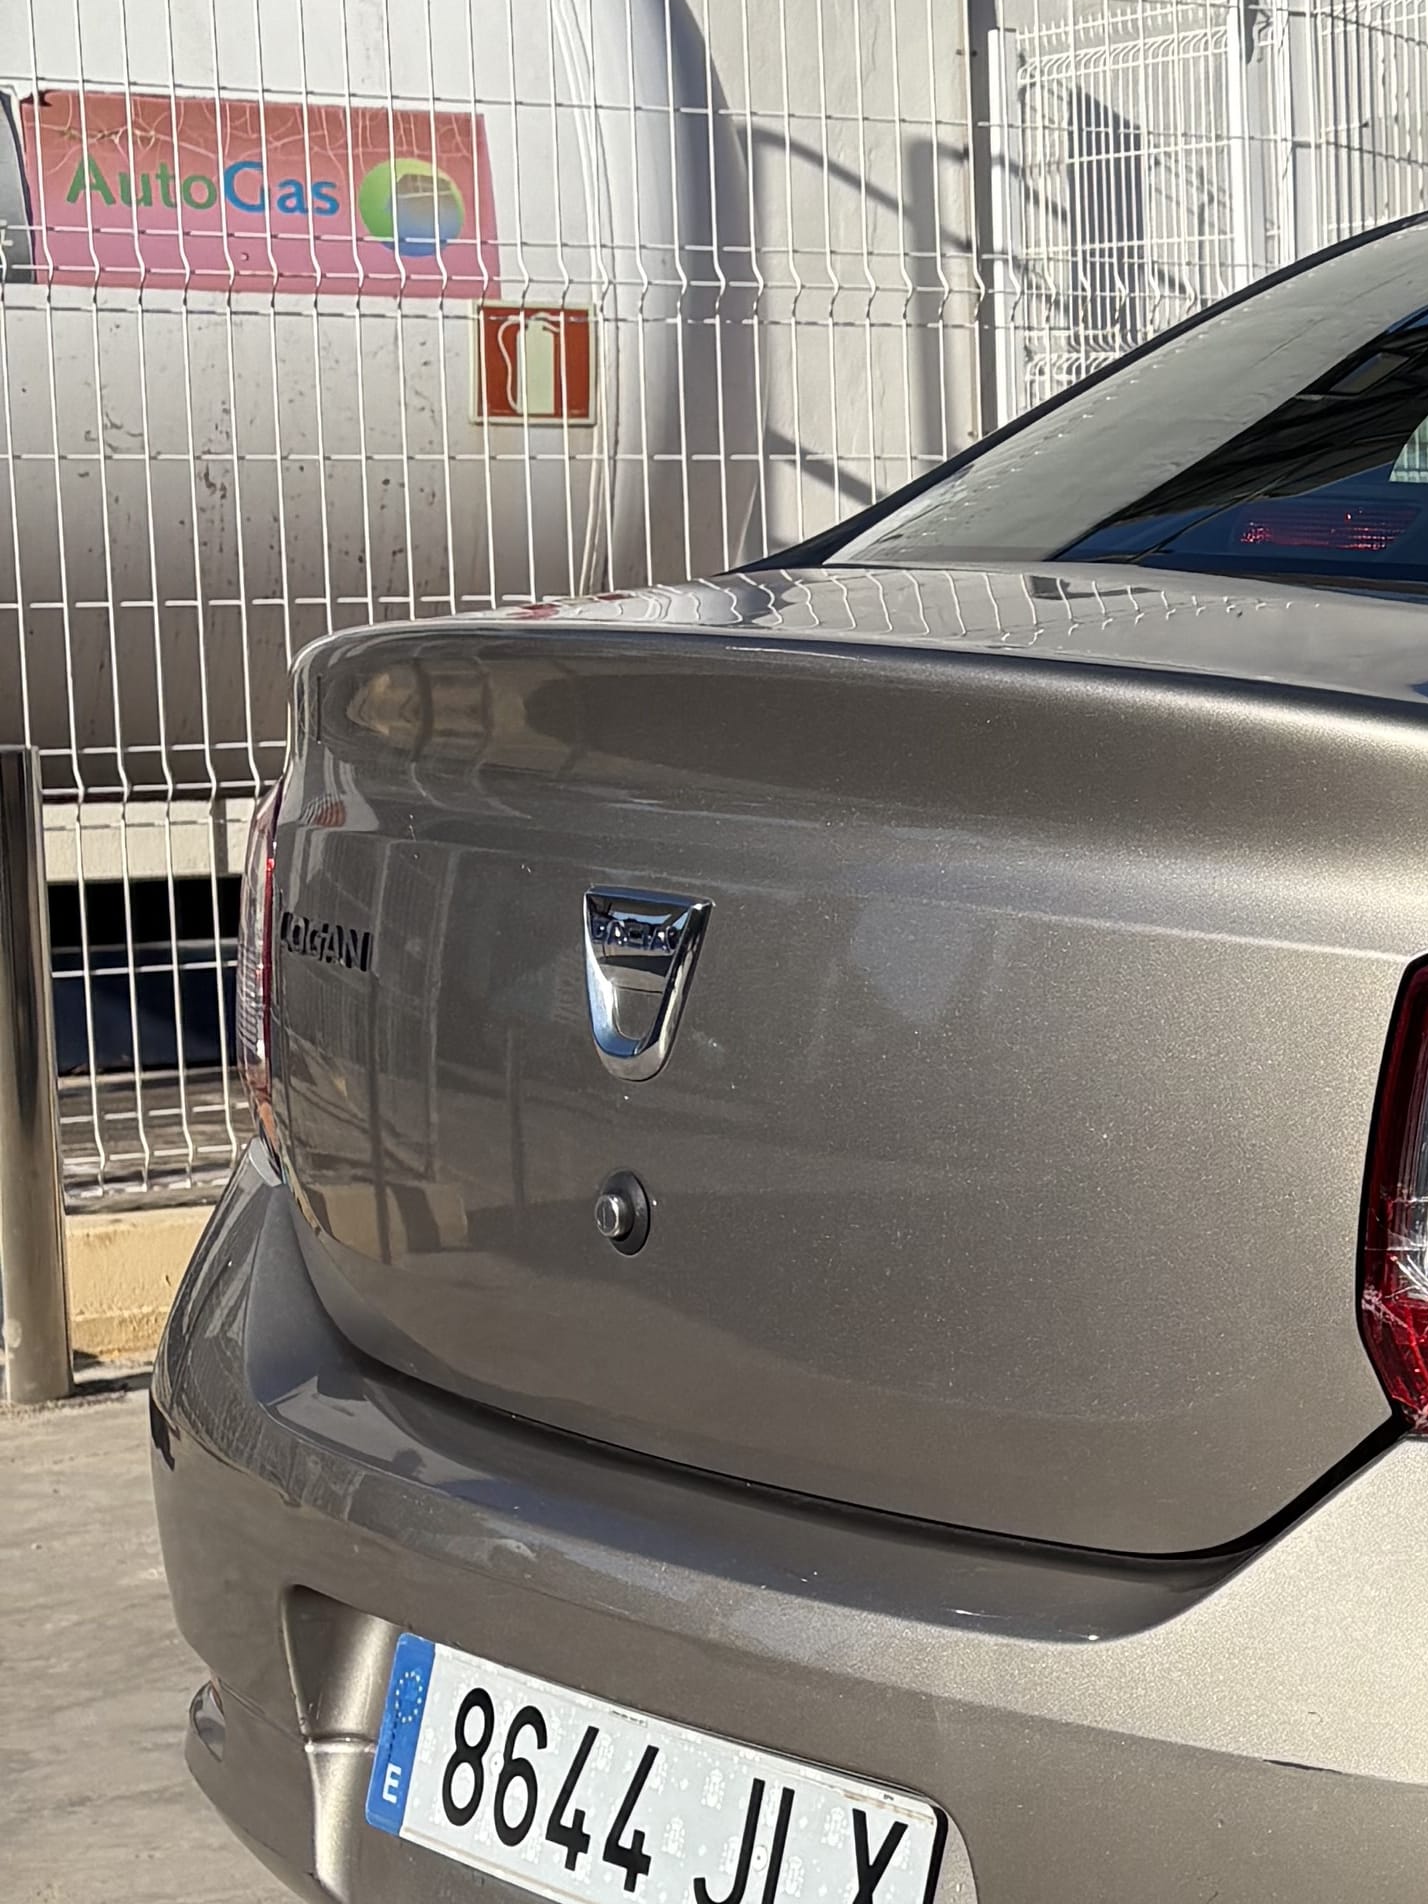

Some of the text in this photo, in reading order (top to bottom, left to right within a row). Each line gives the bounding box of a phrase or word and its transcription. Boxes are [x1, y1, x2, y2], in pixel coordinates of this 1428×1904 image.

[66, 151, 340, 217] AutoGas
[280, 911, 374, 972] LOGAN
[381, 1763, 402, 1804] E
[441, 1686, 660, 1894] 8644
